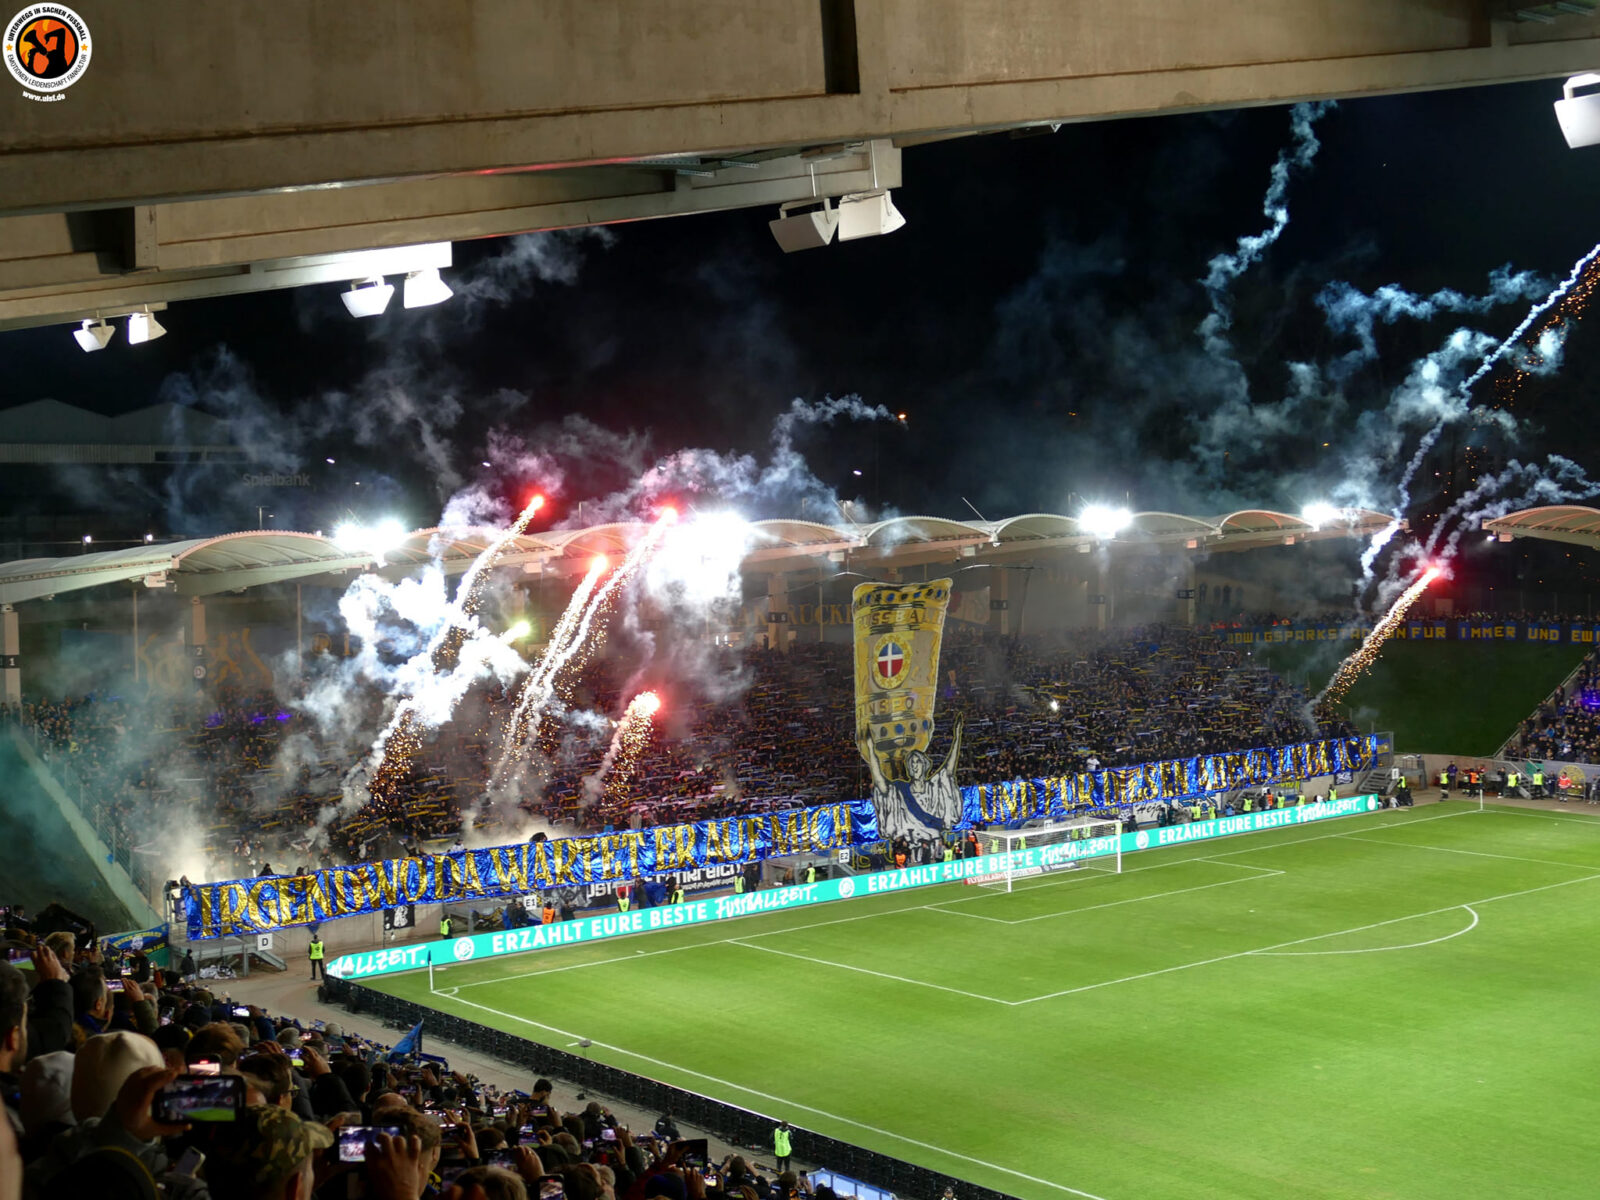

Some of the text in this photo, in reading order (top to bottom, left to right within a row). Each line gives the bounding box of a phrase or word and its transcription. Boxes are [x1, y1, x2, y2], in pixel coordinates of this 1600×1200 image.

[242, 473, 310, 488] Spielbank
[1460, 626, 1517, 638] IMMER
[1528, 628, 1560, 641] UND
[1159, 821, 1216, 844] ERZÄHLT
[1219, 815, 1252, 834] EURE
[1255, 810, 1292, 828] BESTE
[199, 856, 429, 937] IRGENDWO
[434, 851, 486, 901] DA
[489, 832, 647, 891] WARTET
[653, 824, 700, 873] ER
[703, 815, 764, 866] AUF
[770, 804, 852, 856] MICH
[978, 781, 1037, 822] UND
[1102, 761, 1190, 807] DIESEN
[1197, 751, 1273, 793] ABEND
[1338, 736, 1373, 771] ICH
[840, 852, 848, 861] E2
[868, 866, 938, 892] ERZÄHLT
[945, 859, 987, 879] EURE
[525, 898, 535, 907] E1
[492, 924, 583, 953] ERZÄHLT
[591, 912, 646, 936] EURE
[649, 902, 708, 927] BESTE
[262, 937, 268, 947] D
